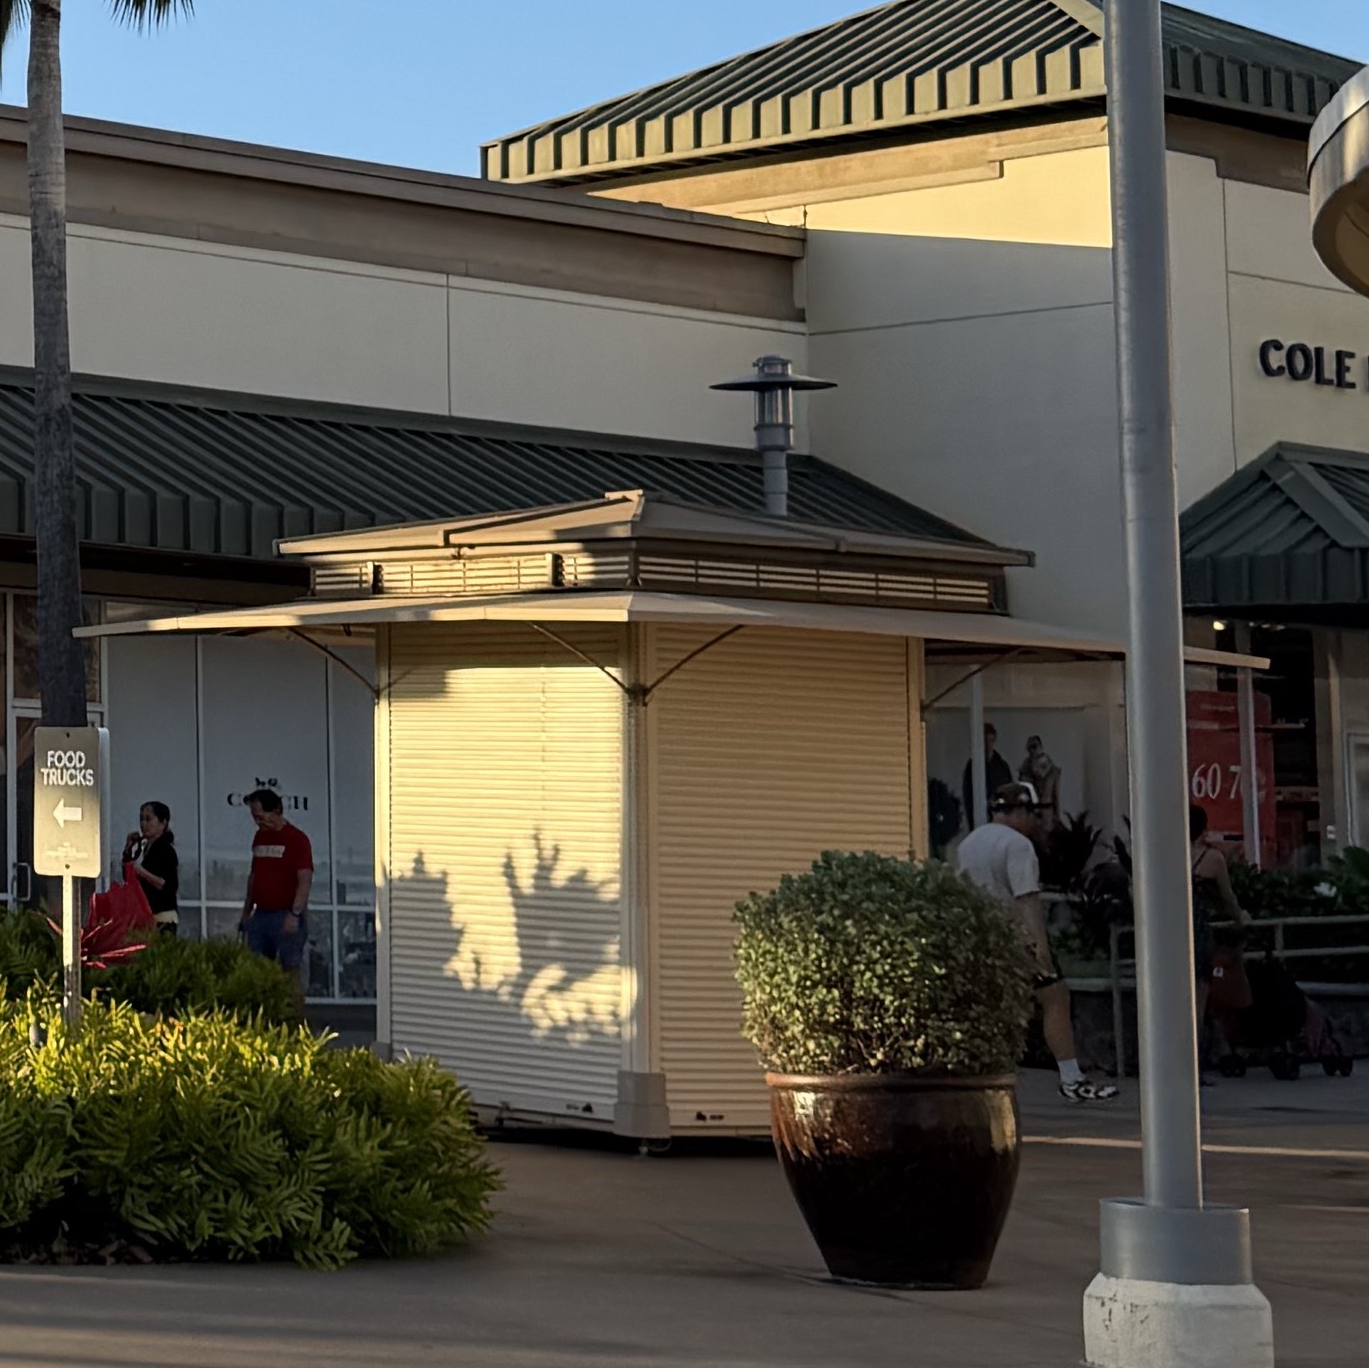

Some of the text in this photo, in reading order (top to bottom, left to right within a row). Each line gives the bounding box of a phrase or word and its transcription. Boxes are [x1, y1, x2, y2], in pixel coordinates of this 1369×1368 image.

[1259, 339, 1356, 389] COLE
[47, 750, 86, 768] FOOD
[40, 768, 95, 787] TRUCKS
